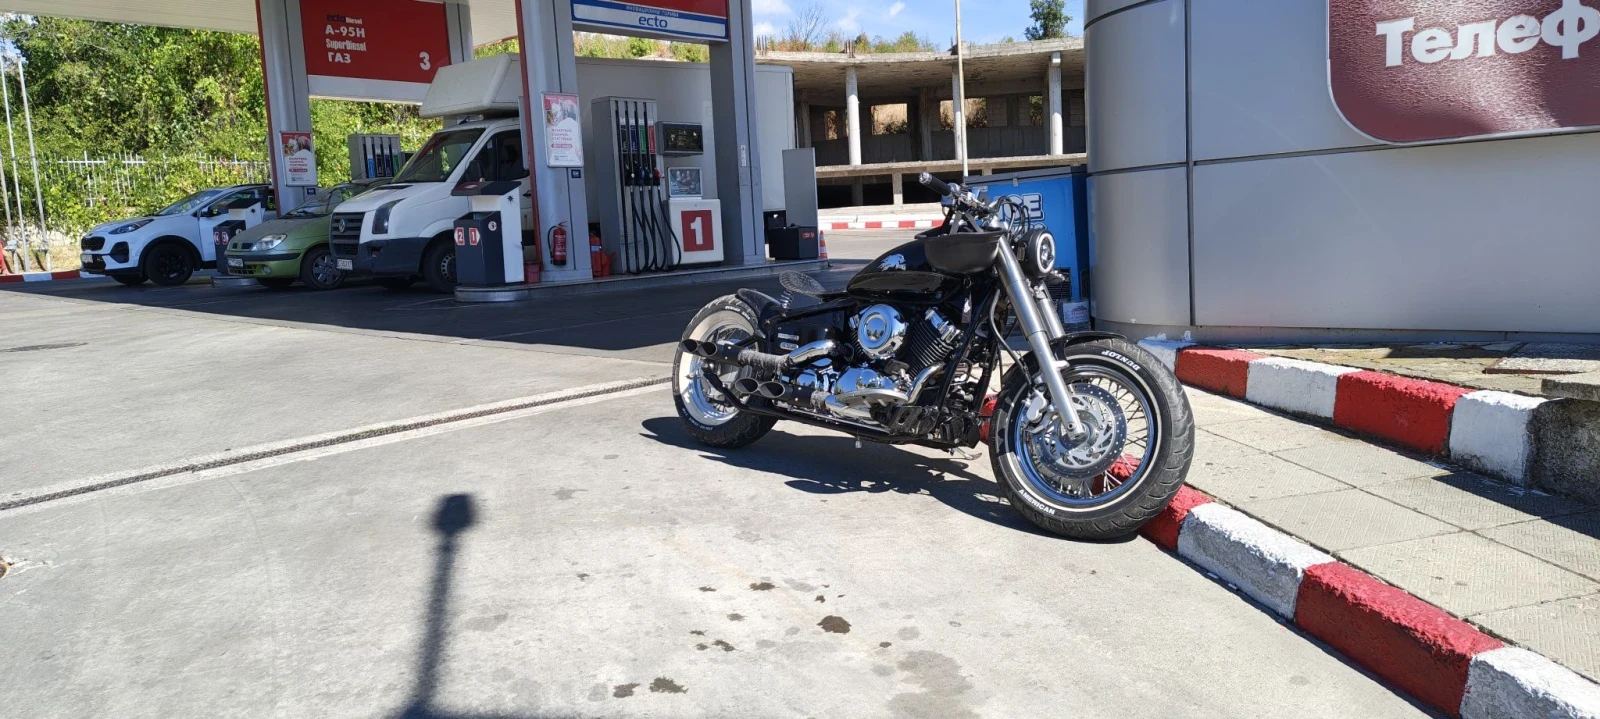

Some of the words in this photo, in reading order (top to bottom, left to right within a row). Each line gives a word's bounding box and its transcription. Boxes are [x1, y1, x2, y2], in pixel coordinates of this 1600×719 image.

[638, 15, 668, 28] ecto
[1375, 0, 1600, 68] Телеф
[325, 38, 367, 52] SuperDiesel
[327, 52, 352, 64] ГАЗ
[419, 51, 431, 70] 3
[458, 231, 464, 241] 2
[471, 231, 476, 241] 1
[690, 216, 704, 245] 1
[1101, 349, 1141, 371] DUNLOP
[1018, 488, 1056, 515] AMERICAN
